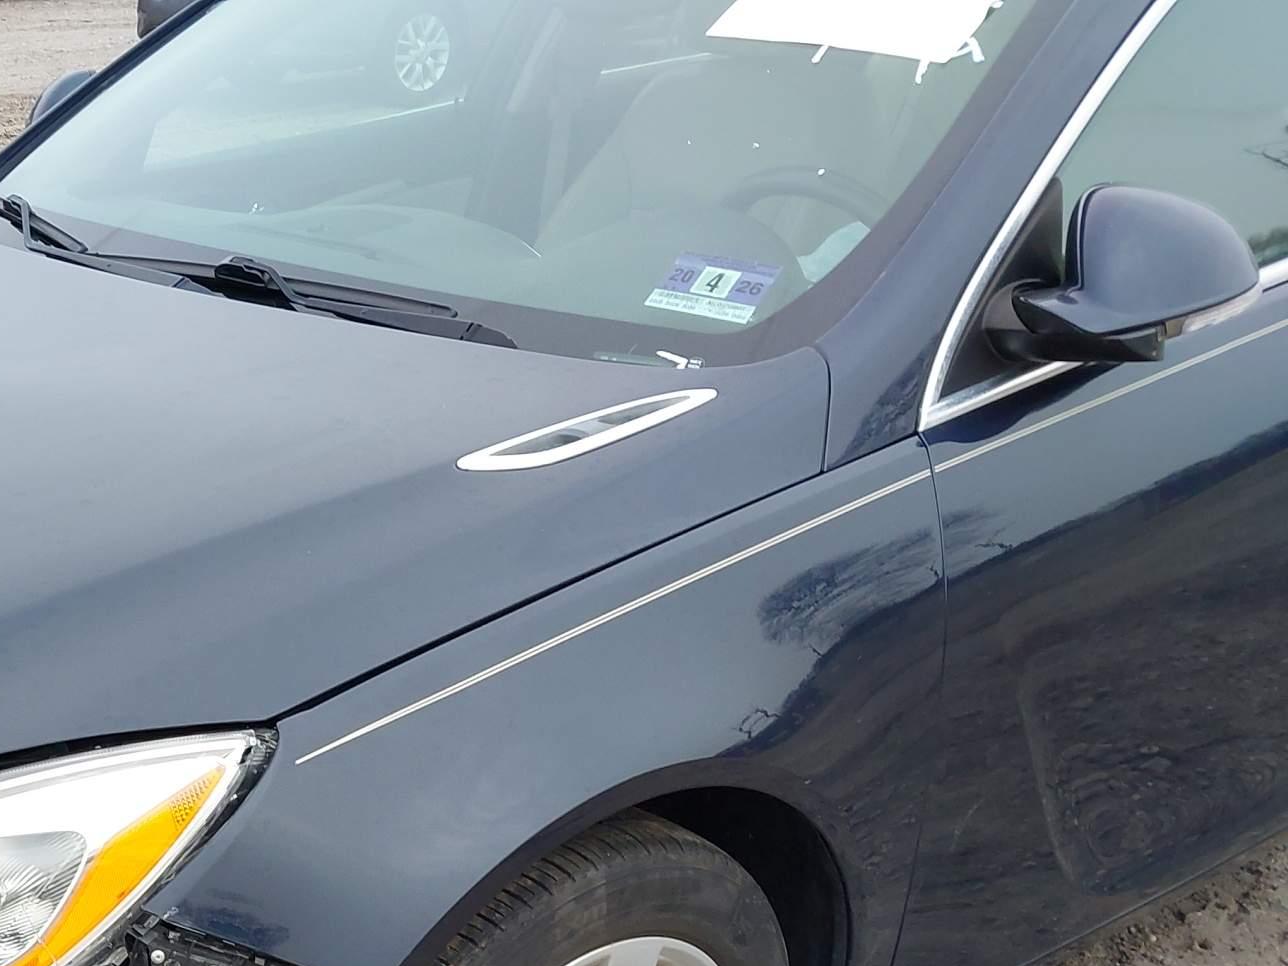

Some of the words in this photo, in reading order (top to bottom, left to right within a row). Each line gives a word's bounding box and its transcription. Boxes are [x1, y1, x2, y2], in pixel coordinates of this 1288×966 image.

[669, 268, 695, 283] 20
[705, 272, 726, 293] 4
[735, 281, 764, 296] 26
